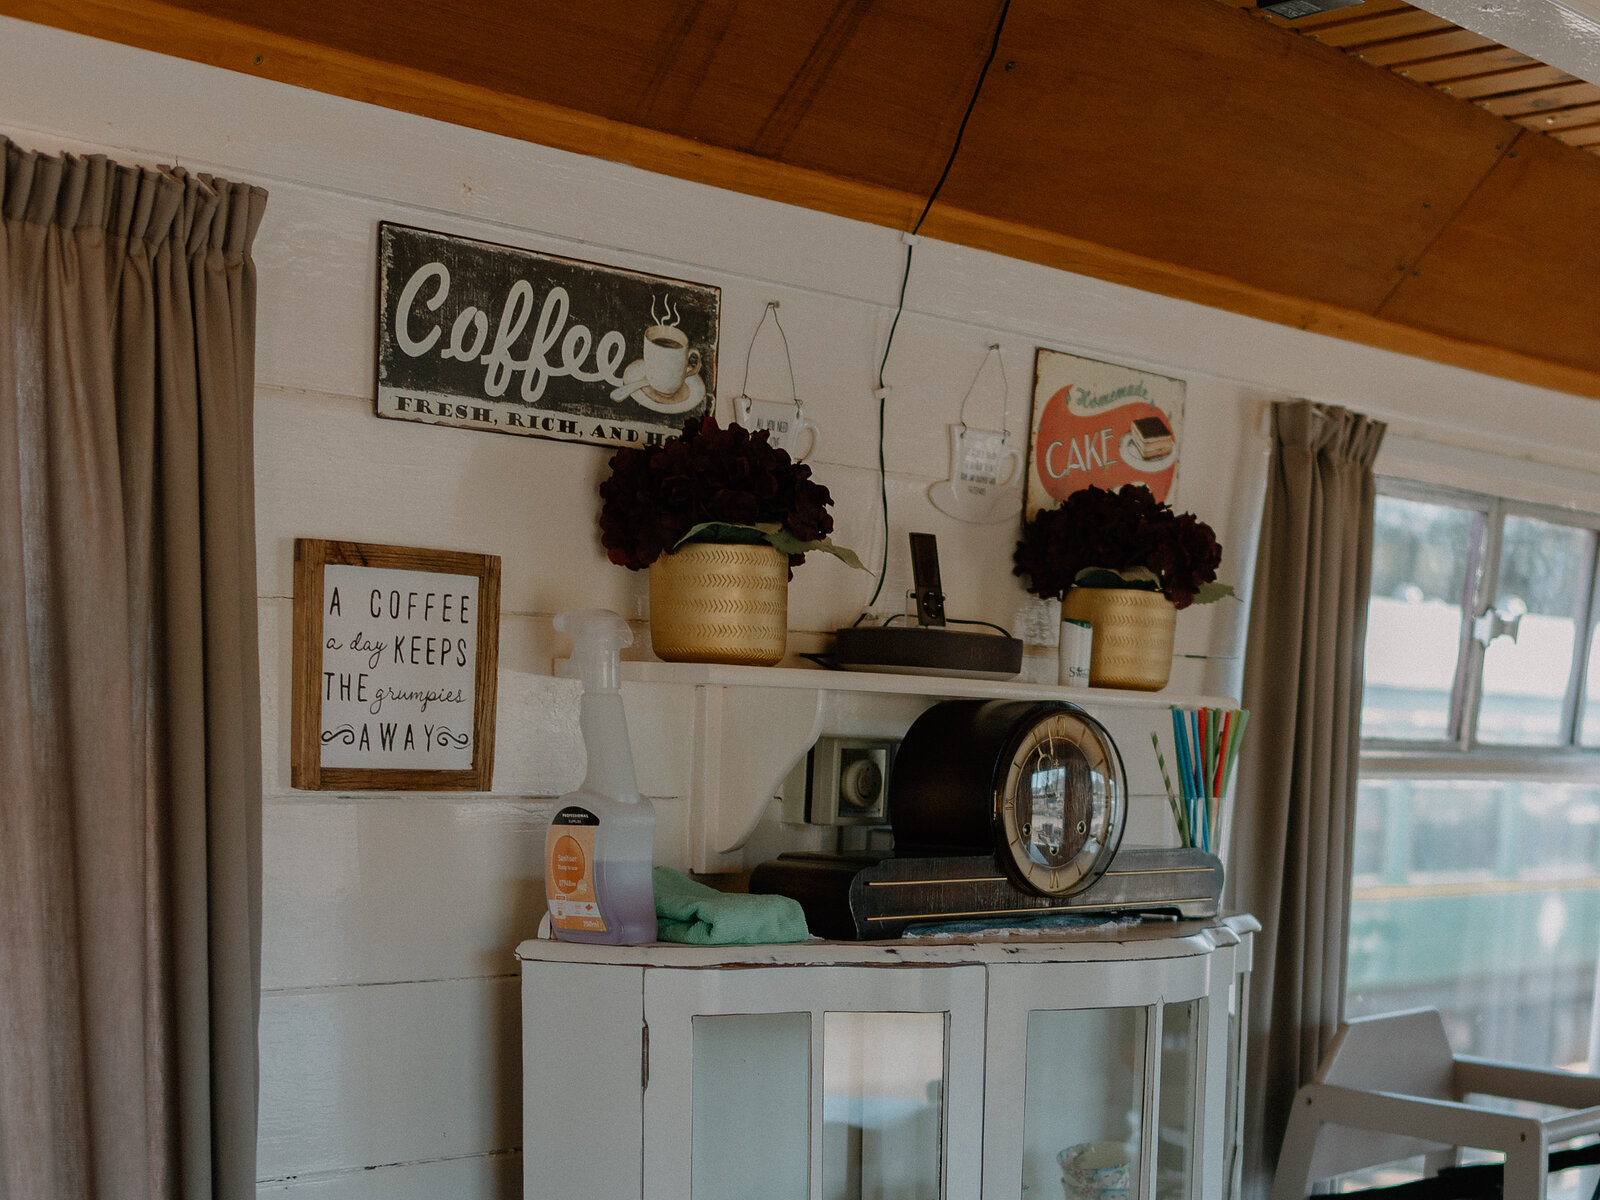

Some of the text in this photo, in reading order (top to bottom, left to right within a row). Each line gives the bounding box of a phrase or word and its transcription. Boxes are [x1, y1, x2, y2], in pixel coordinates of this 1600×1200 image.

[395, 262, 626, 402] Coffee
[394, 395, 498, 426] FRESH,
[506, 411, 583, 438] RICH,
[590, 423, 639, 442] AND
[1046, 427, 1118, 479] CAKE
[329, 586, 469, 623] A COFFEE
[326, 632, 467, 669] a day KEEPS
[323, 672, 469, 715] THE grumpies
[358, 723, 435, 752] AWAY
